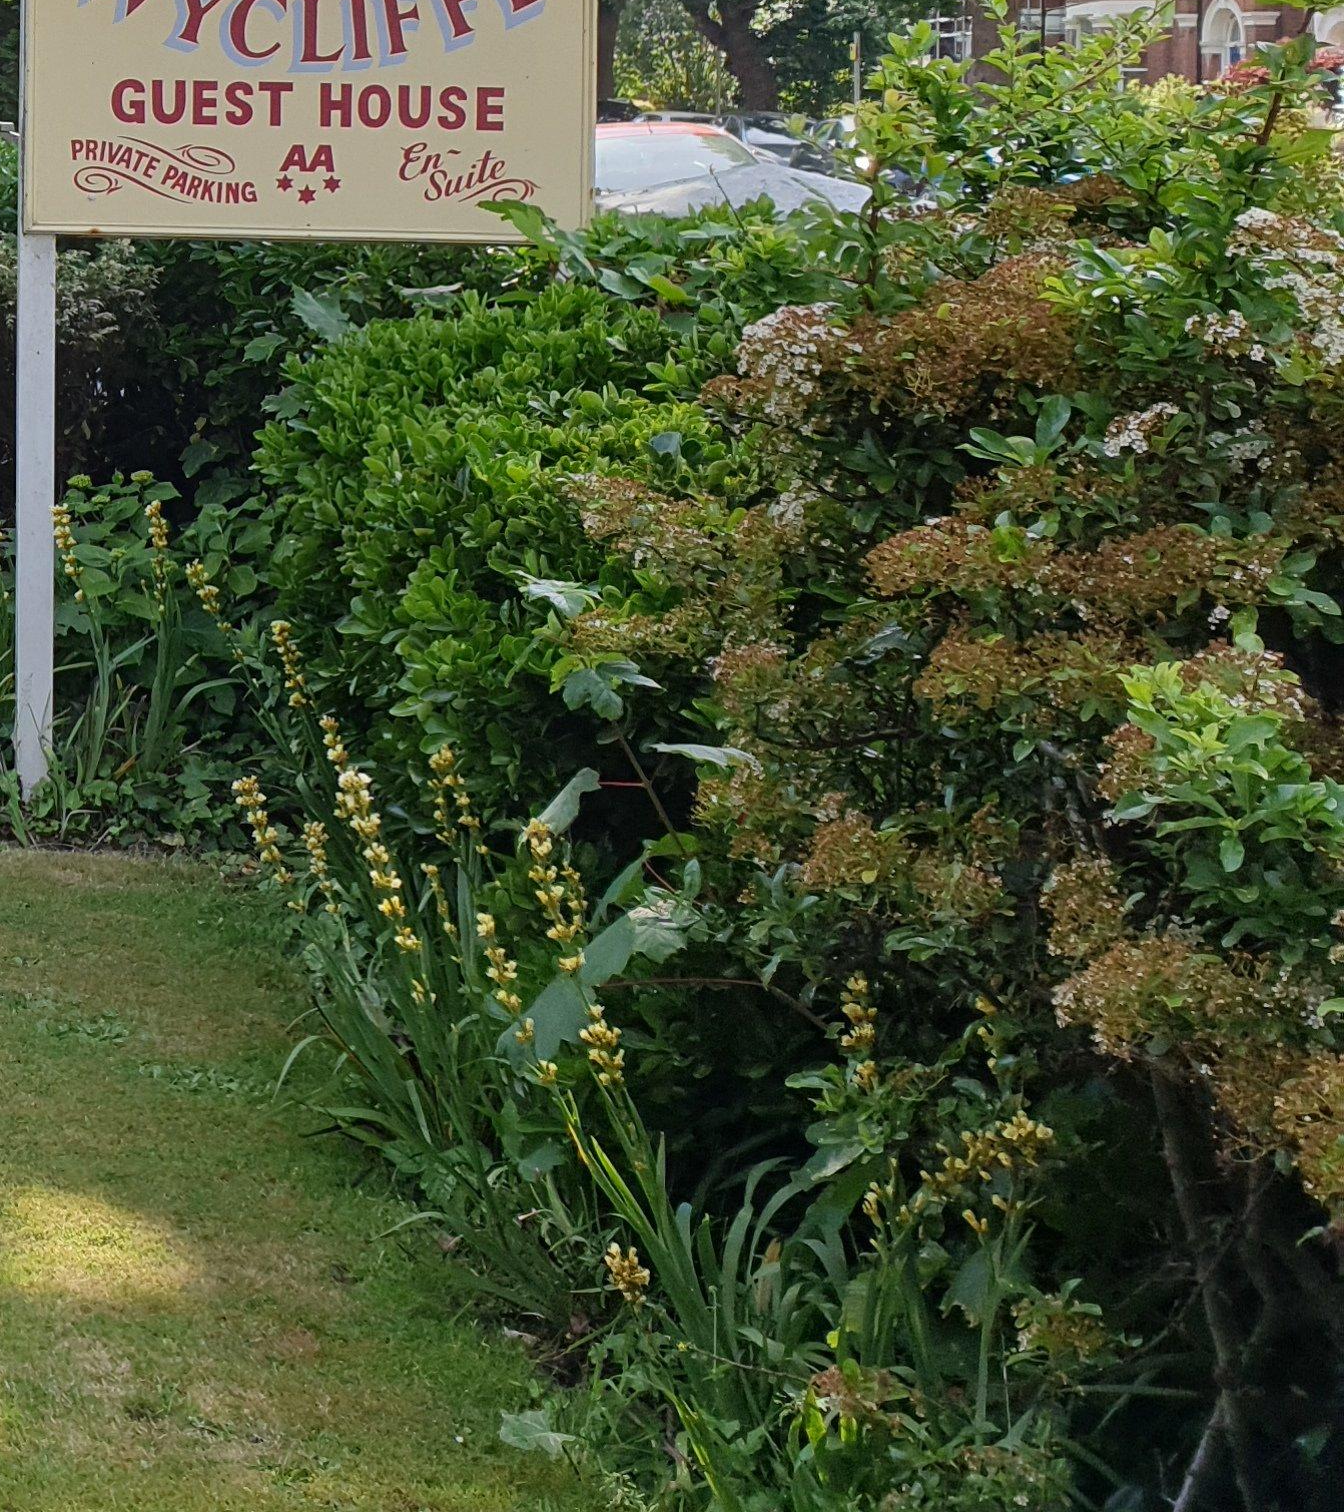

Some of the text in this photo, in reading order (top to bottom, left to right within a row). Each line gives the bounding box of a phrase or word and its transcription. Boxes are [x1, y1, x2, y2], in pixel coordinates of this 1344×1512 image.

[110, 78, 505, 132] GUEST HOUSE
[70, 139, 258, 205] PRIVATE PARKING
[280, 143, 336, 174] AA
[424, 149, 506, 202] Suite
